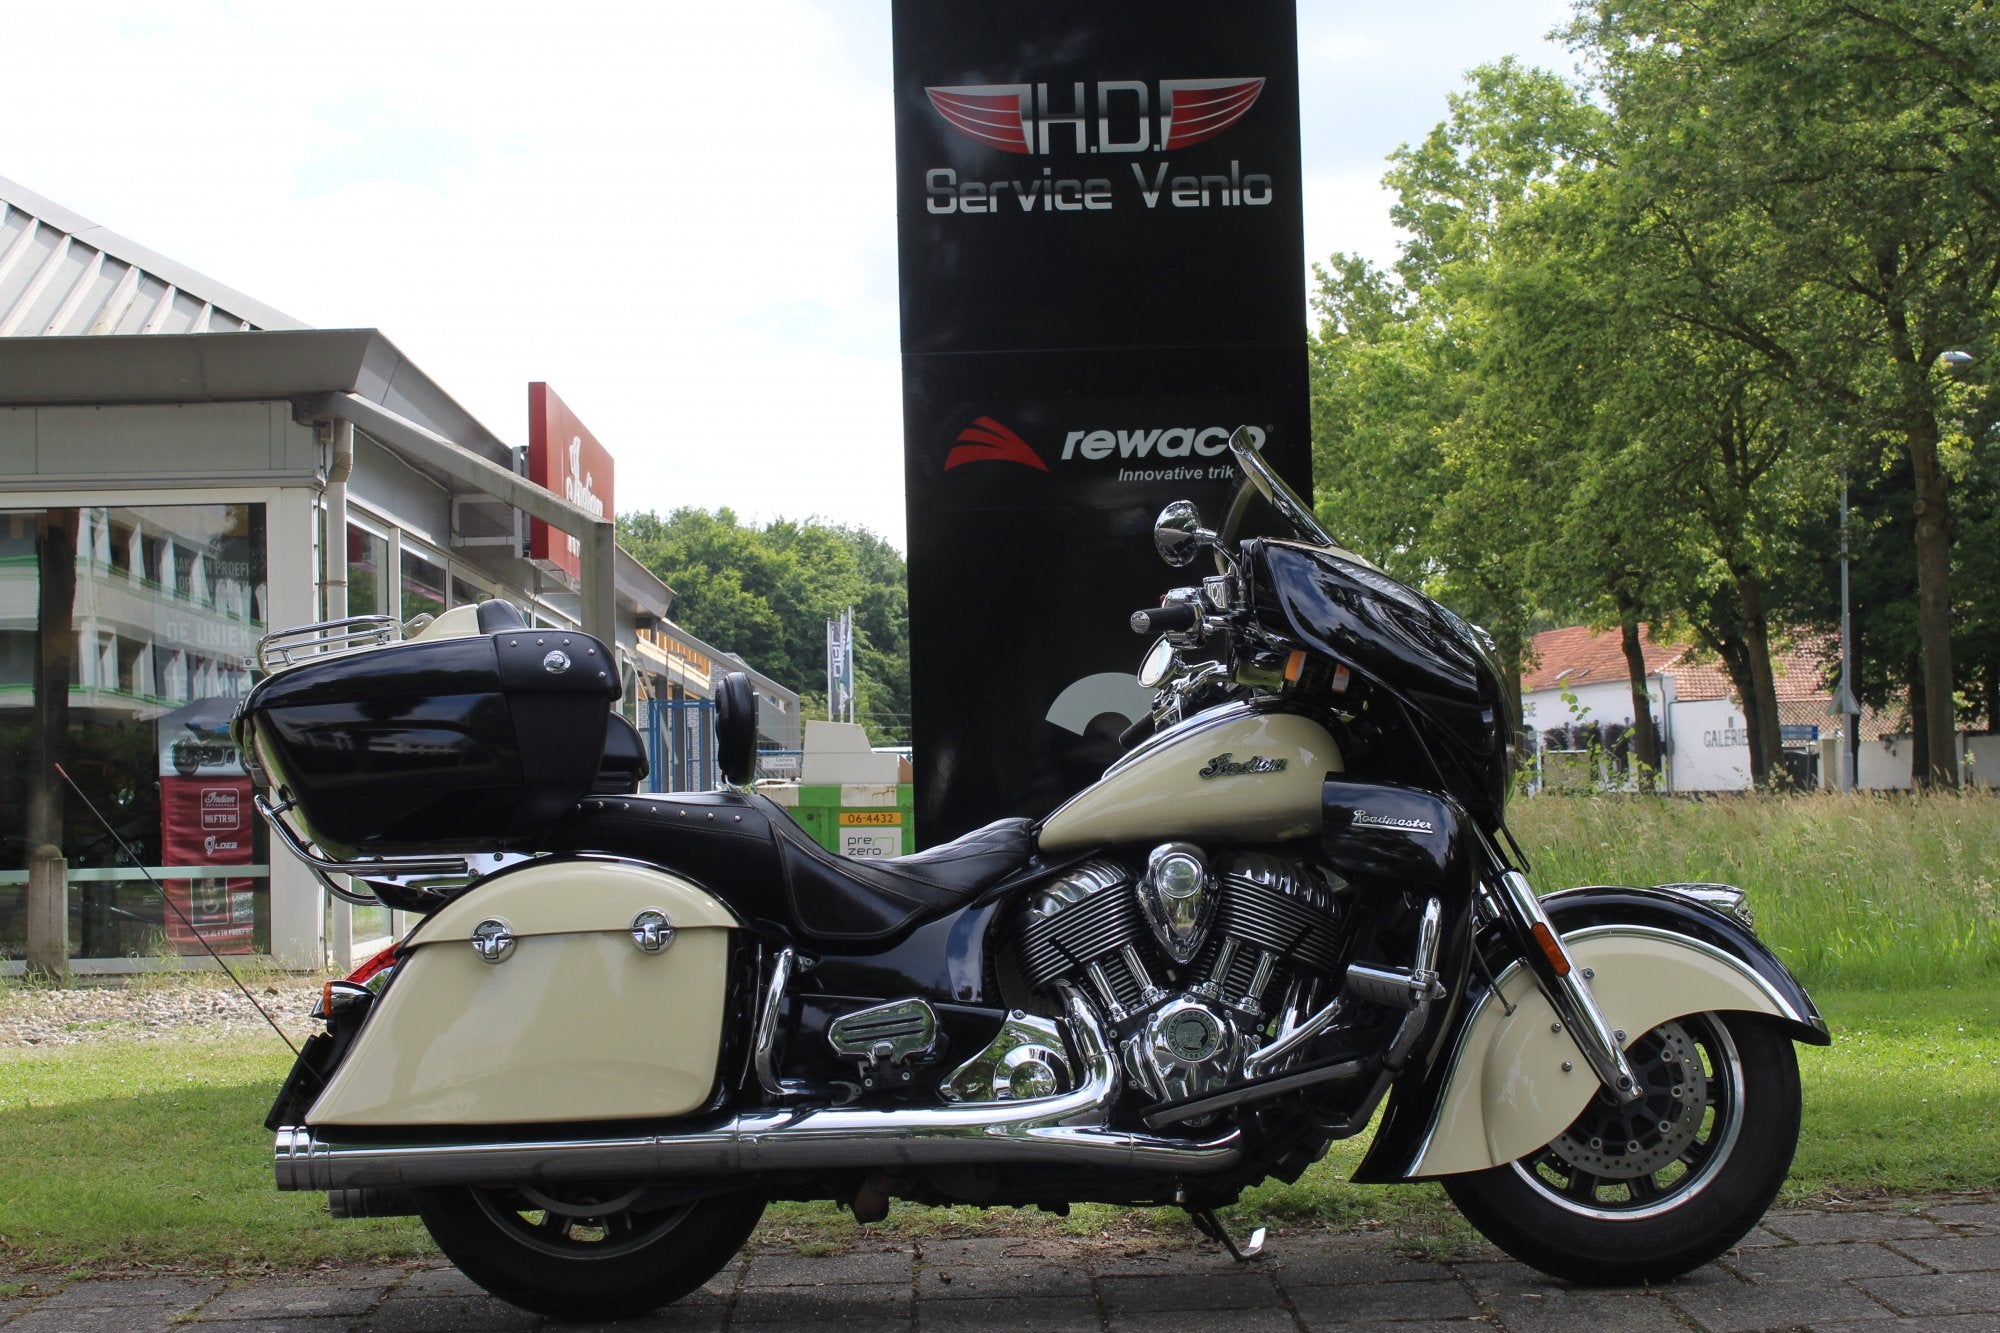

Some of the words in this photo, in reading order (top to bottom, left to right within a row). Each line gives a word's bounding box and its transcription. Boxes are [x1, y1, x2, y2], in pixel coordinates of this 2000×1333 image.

[925, 167, 1113, 214] Service
[1131, 160, 1273, 209] Venlo
[1118, 466, 1204, 482] Innovative
[1703, 728, 1749, 748] GALERIE
[1198, 752, 1288, 779] Indian
[204, 791, 236, 804] Indian
[213, 814, 227, 824] FTR
[848, 813, 894, 824] 06-4432
[1352, 809, 1432, 830] Roadmaster
[847, 836, 872, 847] pre
[847, 847, 882, 856] zero
